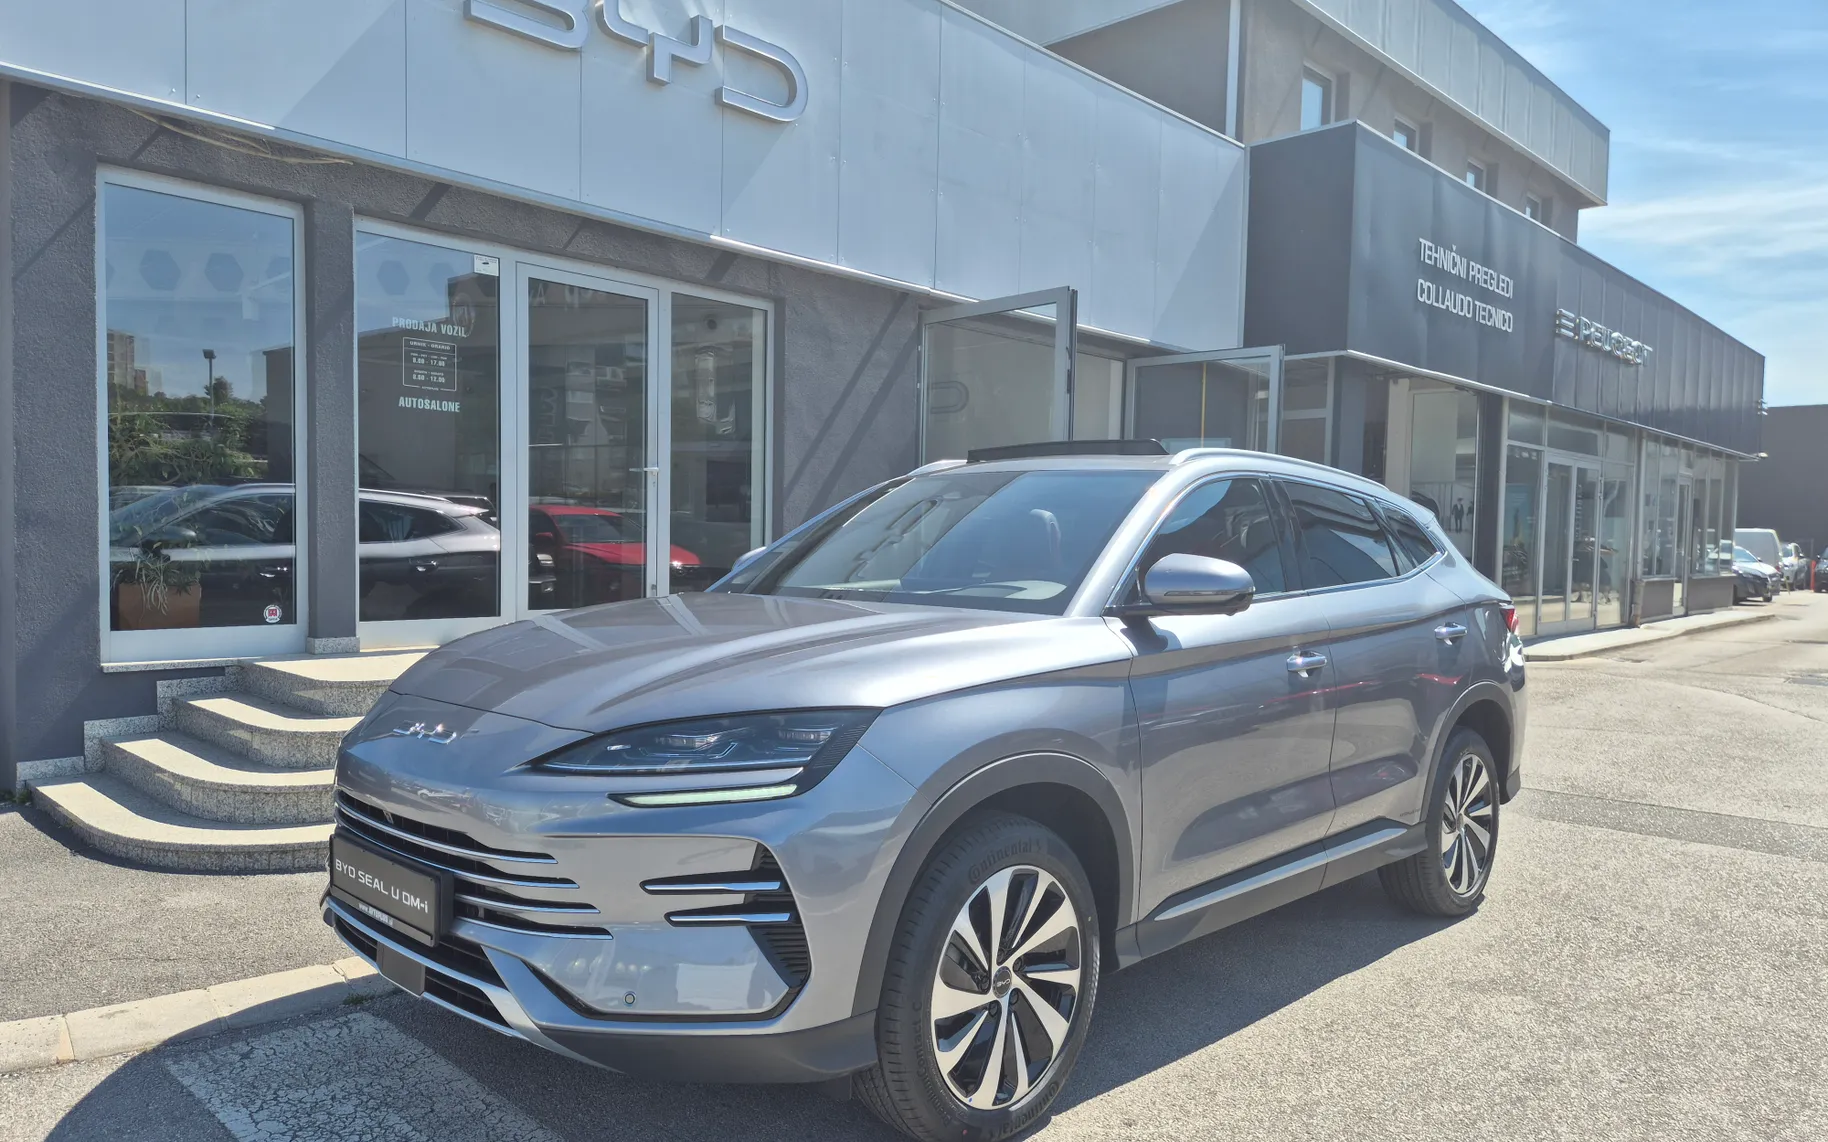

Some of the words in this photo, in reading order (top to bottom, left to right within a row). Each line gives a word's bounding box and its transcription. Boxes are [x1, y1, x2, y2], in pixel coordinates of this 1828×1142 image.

[1419, 237, 1467, 279] TEHNIČNI
[1469, 261, 1514, 299] PREGLEDI
[392, 316, 437, 333] PRODAJA
[440, 323, 467, 338] VOZIL
[1417, 279, 1473, 318] COLLAUDO
[1474, 300, 1513, 332] TECNICO
[1579, 315, 1653, 366] PEUGEOT
[398, 396, 460, 412] AUTOSALONE
[335, 859, 356, 878] BYD
[357, 870, 388, 895] SEAL
[391, 886, 399, 900] U
[402, 891, 428, 913] DM-i
